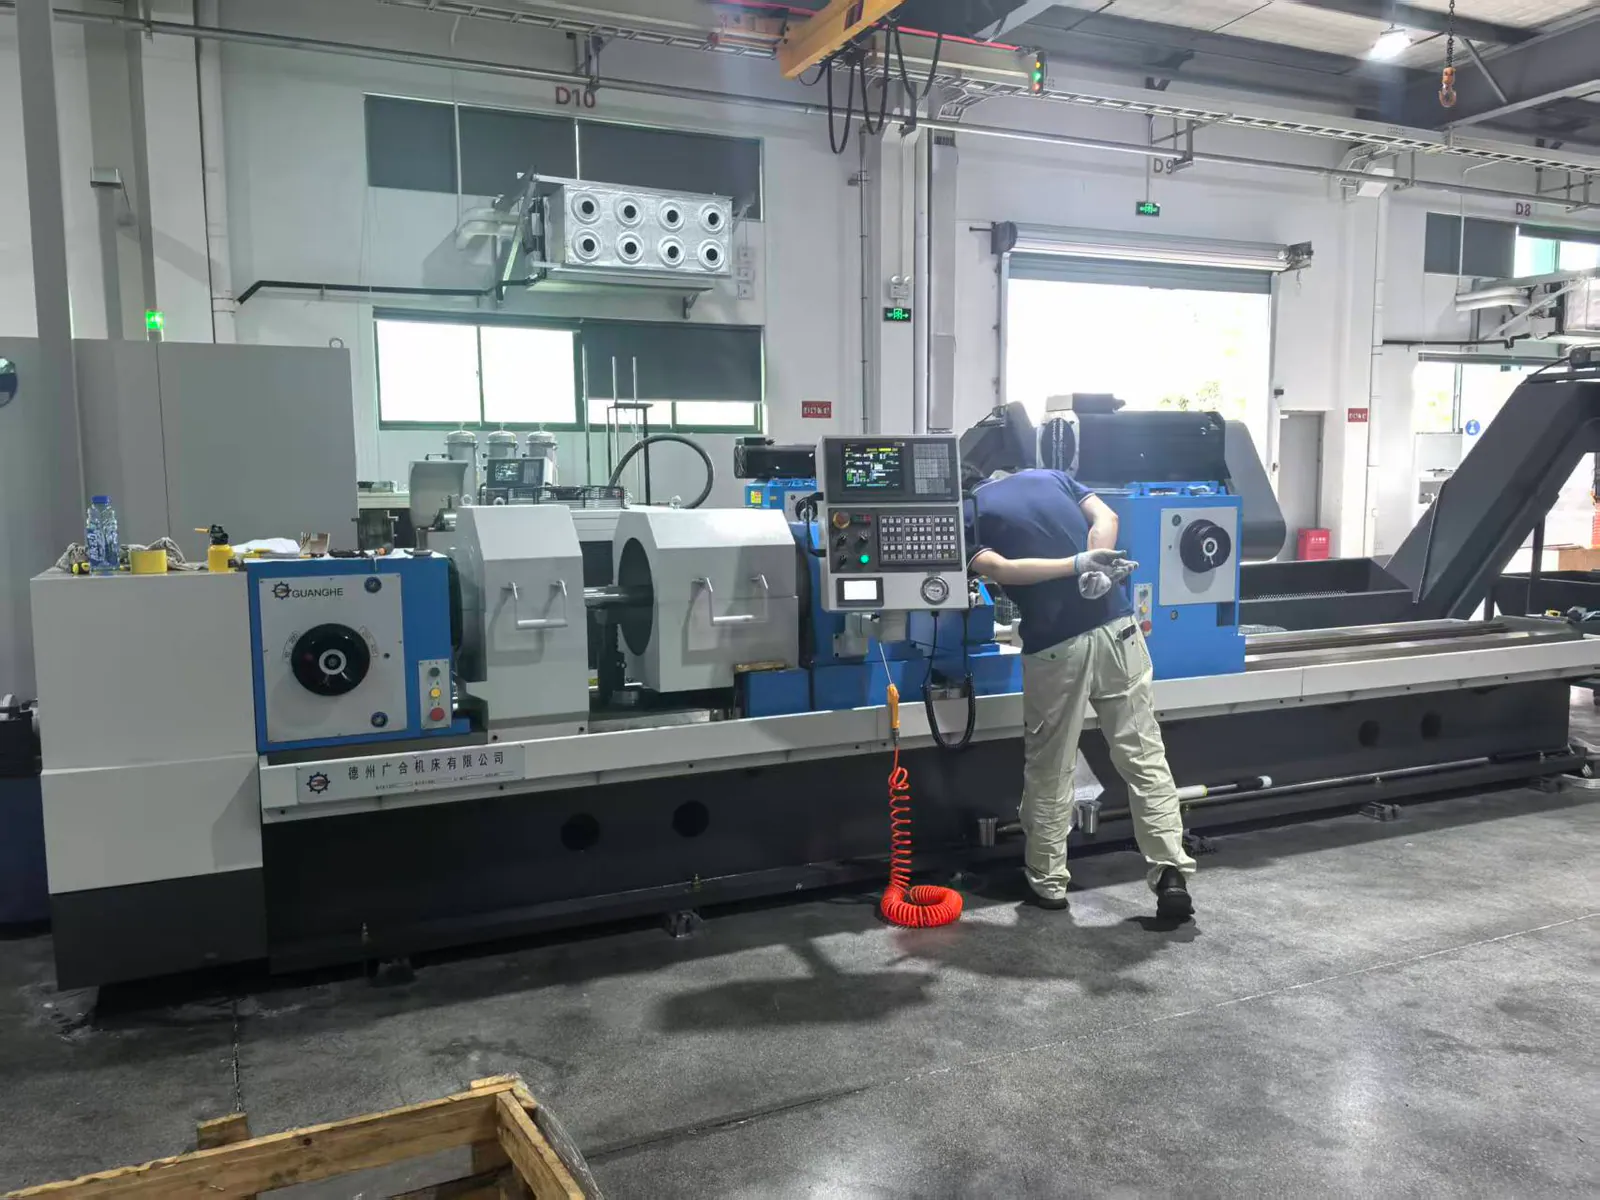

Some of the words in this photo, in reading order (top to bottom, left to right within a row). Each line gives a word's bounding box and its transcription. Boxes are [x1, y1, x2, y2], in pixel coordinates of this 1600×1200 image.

[555, 86, 596, 109] D10
[1153, 157, 1174, 175] D9
[1515, 202, 1532, 217] D8
[291, 587, 344, 598] GUANGHE
[348, 751, 505, 781] 德州广合机床有限公司
